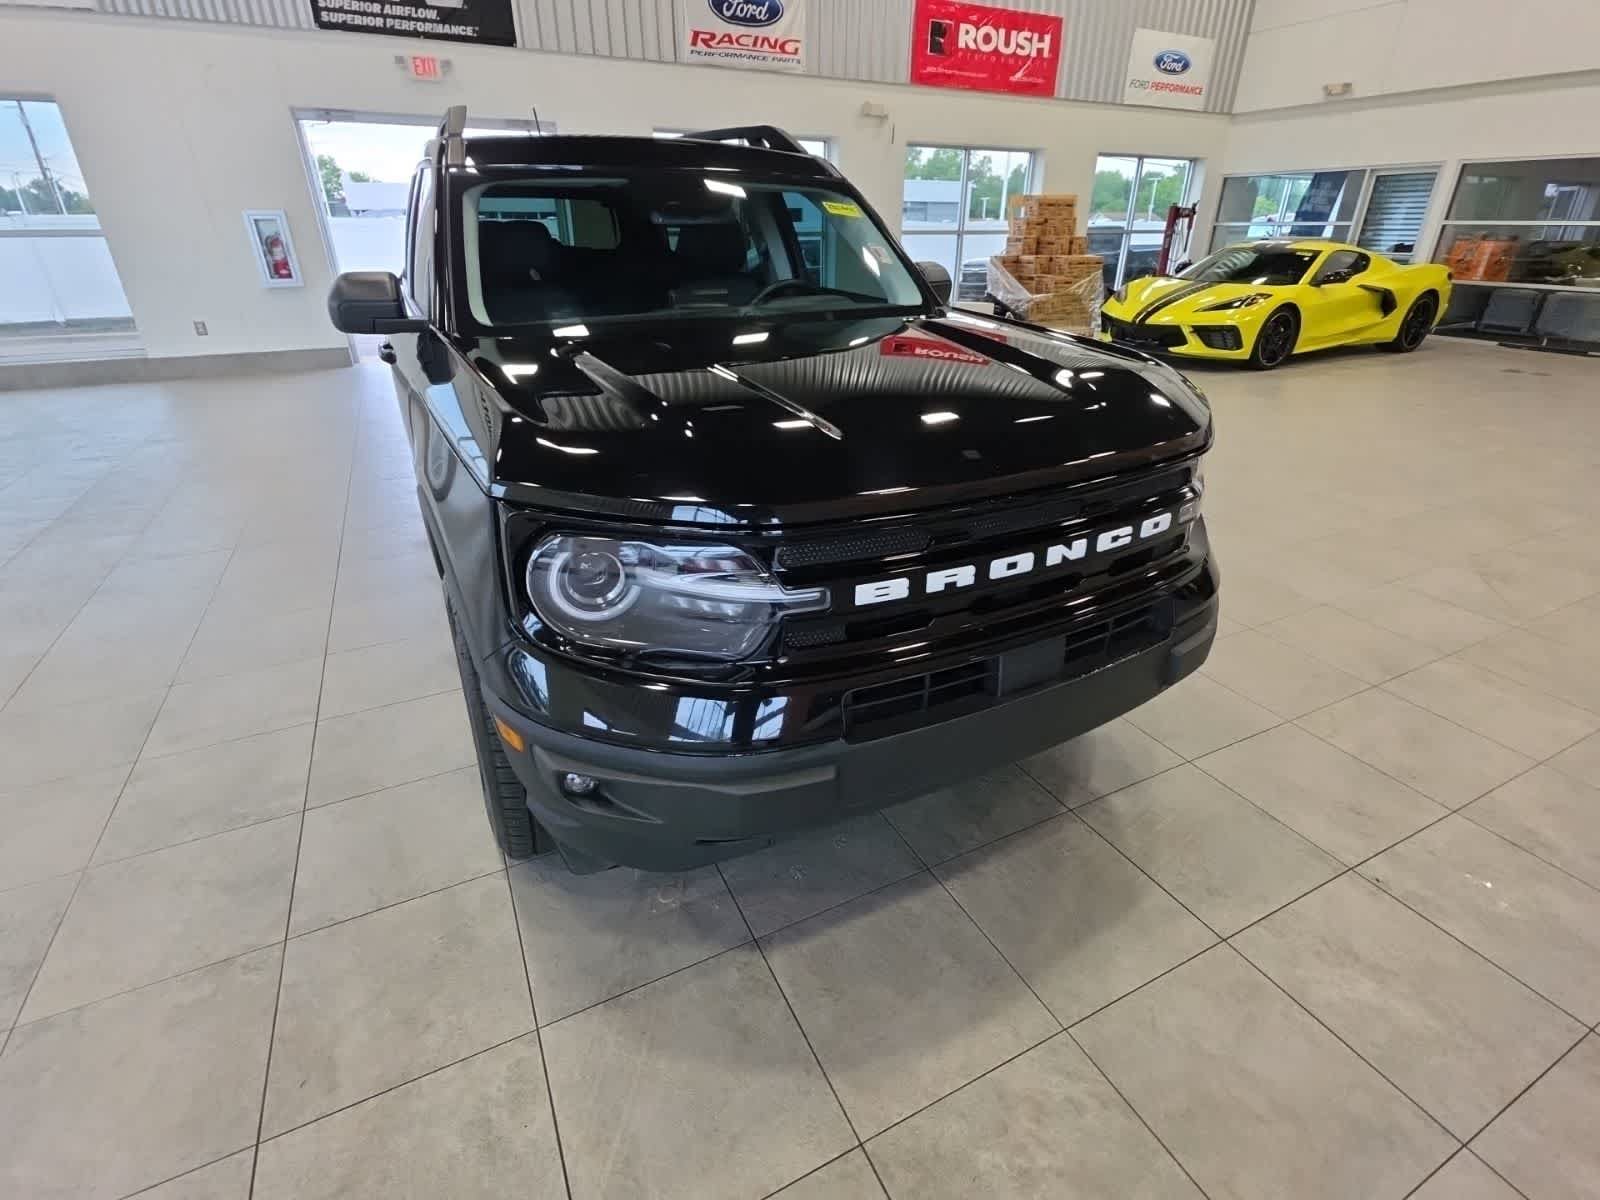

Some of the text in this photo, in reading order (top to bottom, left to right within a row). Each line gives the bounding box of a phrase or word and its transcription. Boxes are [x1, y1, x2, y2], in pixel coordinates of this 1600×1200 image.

[318, 0, 440, 20] SUPERIOR AIRFLOW.
[320, 11, 384, 28] SUPERIOR
[723, 0, 769, 20] Ford
[690, 30, 801, 55] RACING
[958, 22, 1051, 58] ROUSH
[690, 49, 768, 61] PERFORMANCE
[1160, 53, 1185, 71] Ford
[412, 56, 438, 76] EXIT
[1129, 79, 1203, 95] FORD PERFORMANCE
[854, 512, 1172, 607] BRONCO
